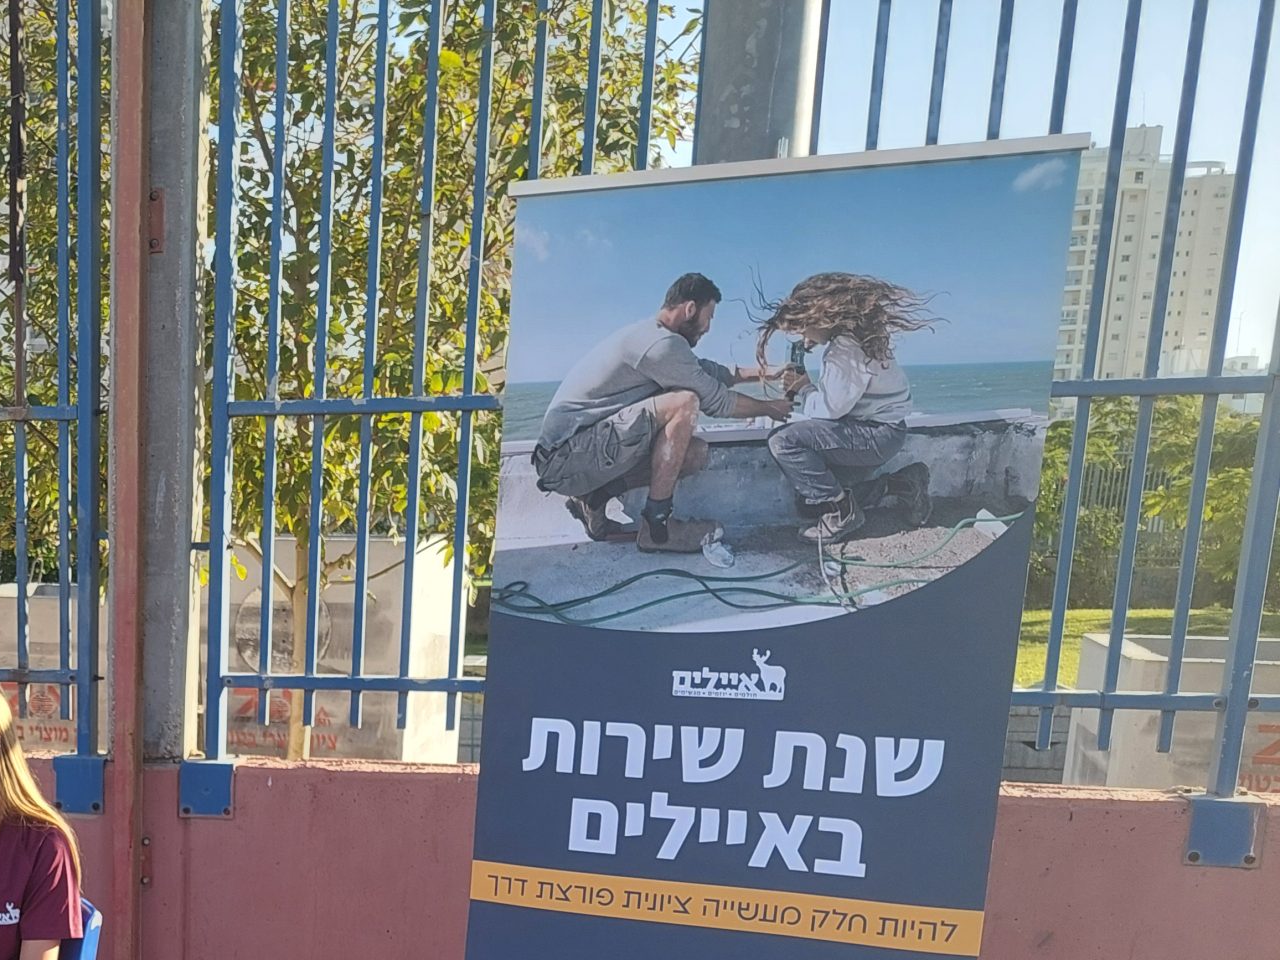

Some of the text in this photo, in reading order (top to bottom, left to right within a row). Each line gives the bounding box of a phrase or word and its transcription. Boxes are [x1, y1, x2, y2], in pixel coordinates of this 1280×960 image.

[672, 667, 760, 692] איילים
[522, 717, 944, 797] שנת שירות
[568, 792, 865, 878] באיילים
[487, 874, 958, 943] להיות חלק מעשייה ציונית פורצת דרך
